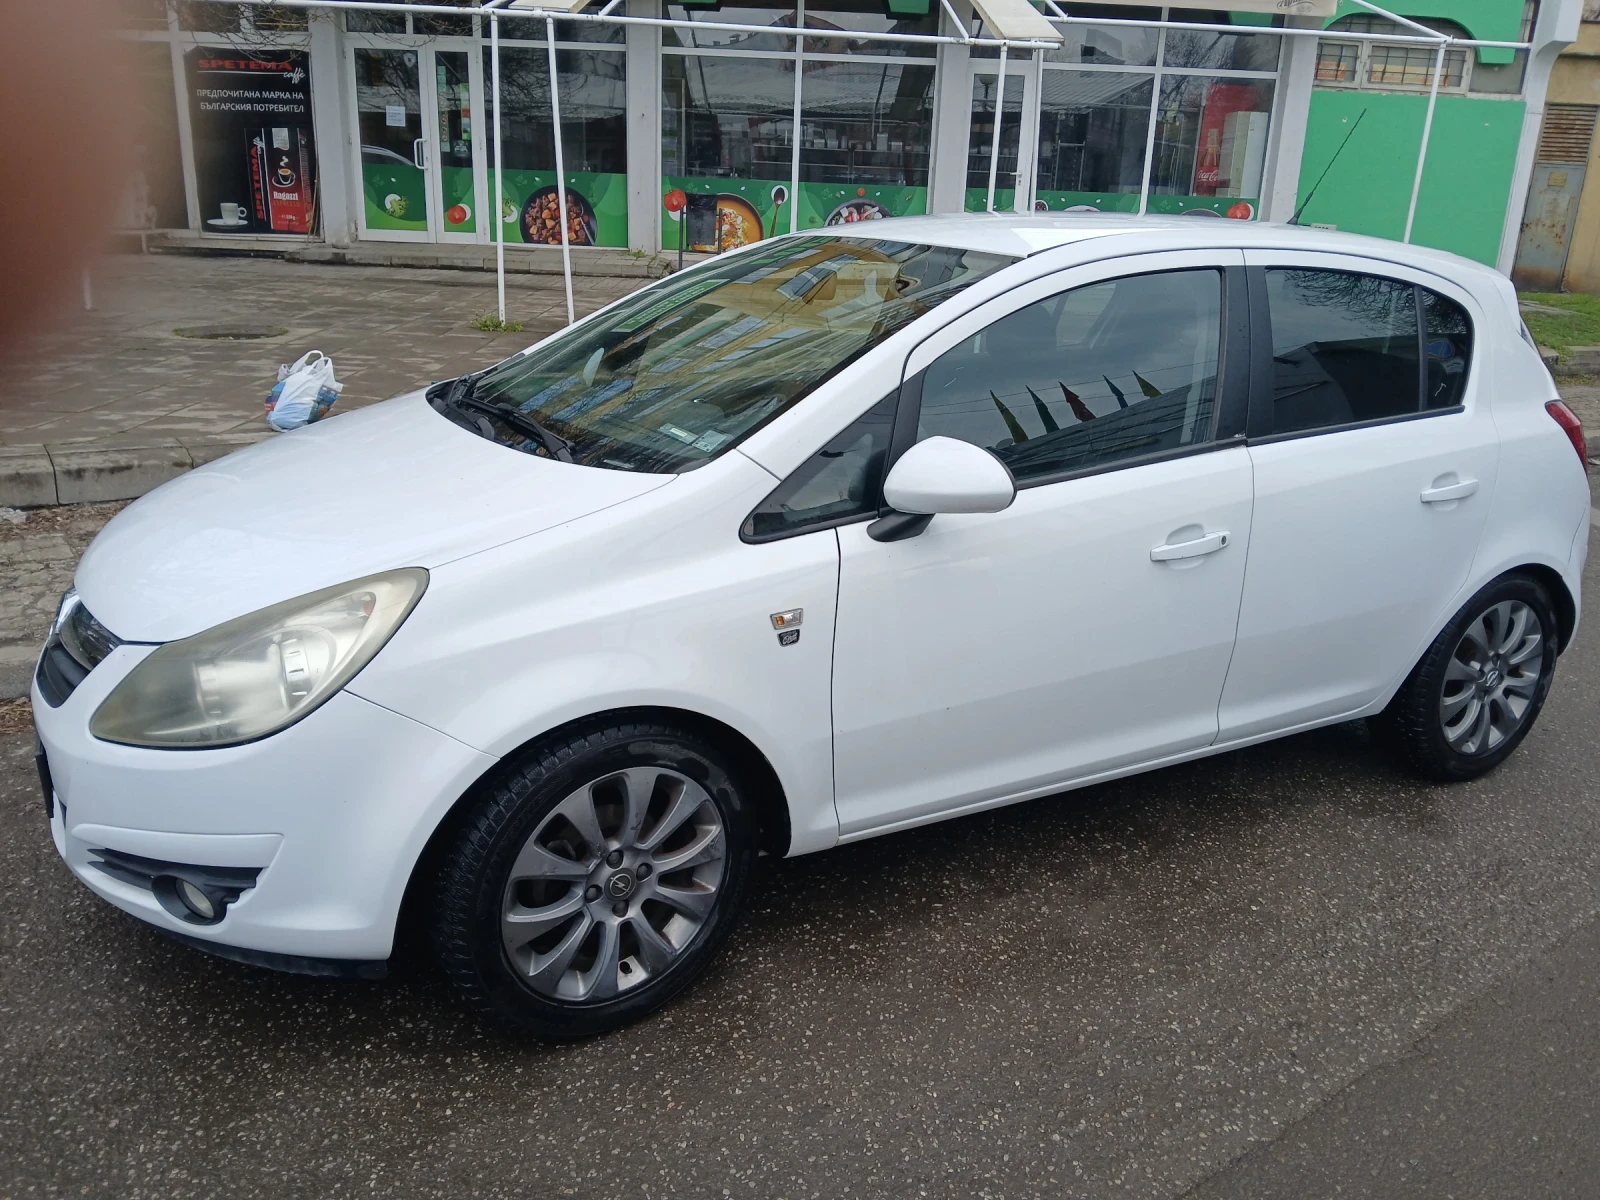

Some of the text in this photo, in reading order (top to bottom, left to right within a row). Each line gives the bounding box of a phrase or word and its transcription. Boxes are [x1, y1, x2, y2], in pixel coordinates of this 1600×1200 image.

[198, 59, 292, 70] SPETEMA
[197, 89, 304, 99] ПРЕДПОЧИТАНА МАРКА НА
[200, 102, 304, 112] БЪЛГАРСКИЯ ПОТРЕБИТЕЛ
[273, 191, 299, 201] Ragazzi
